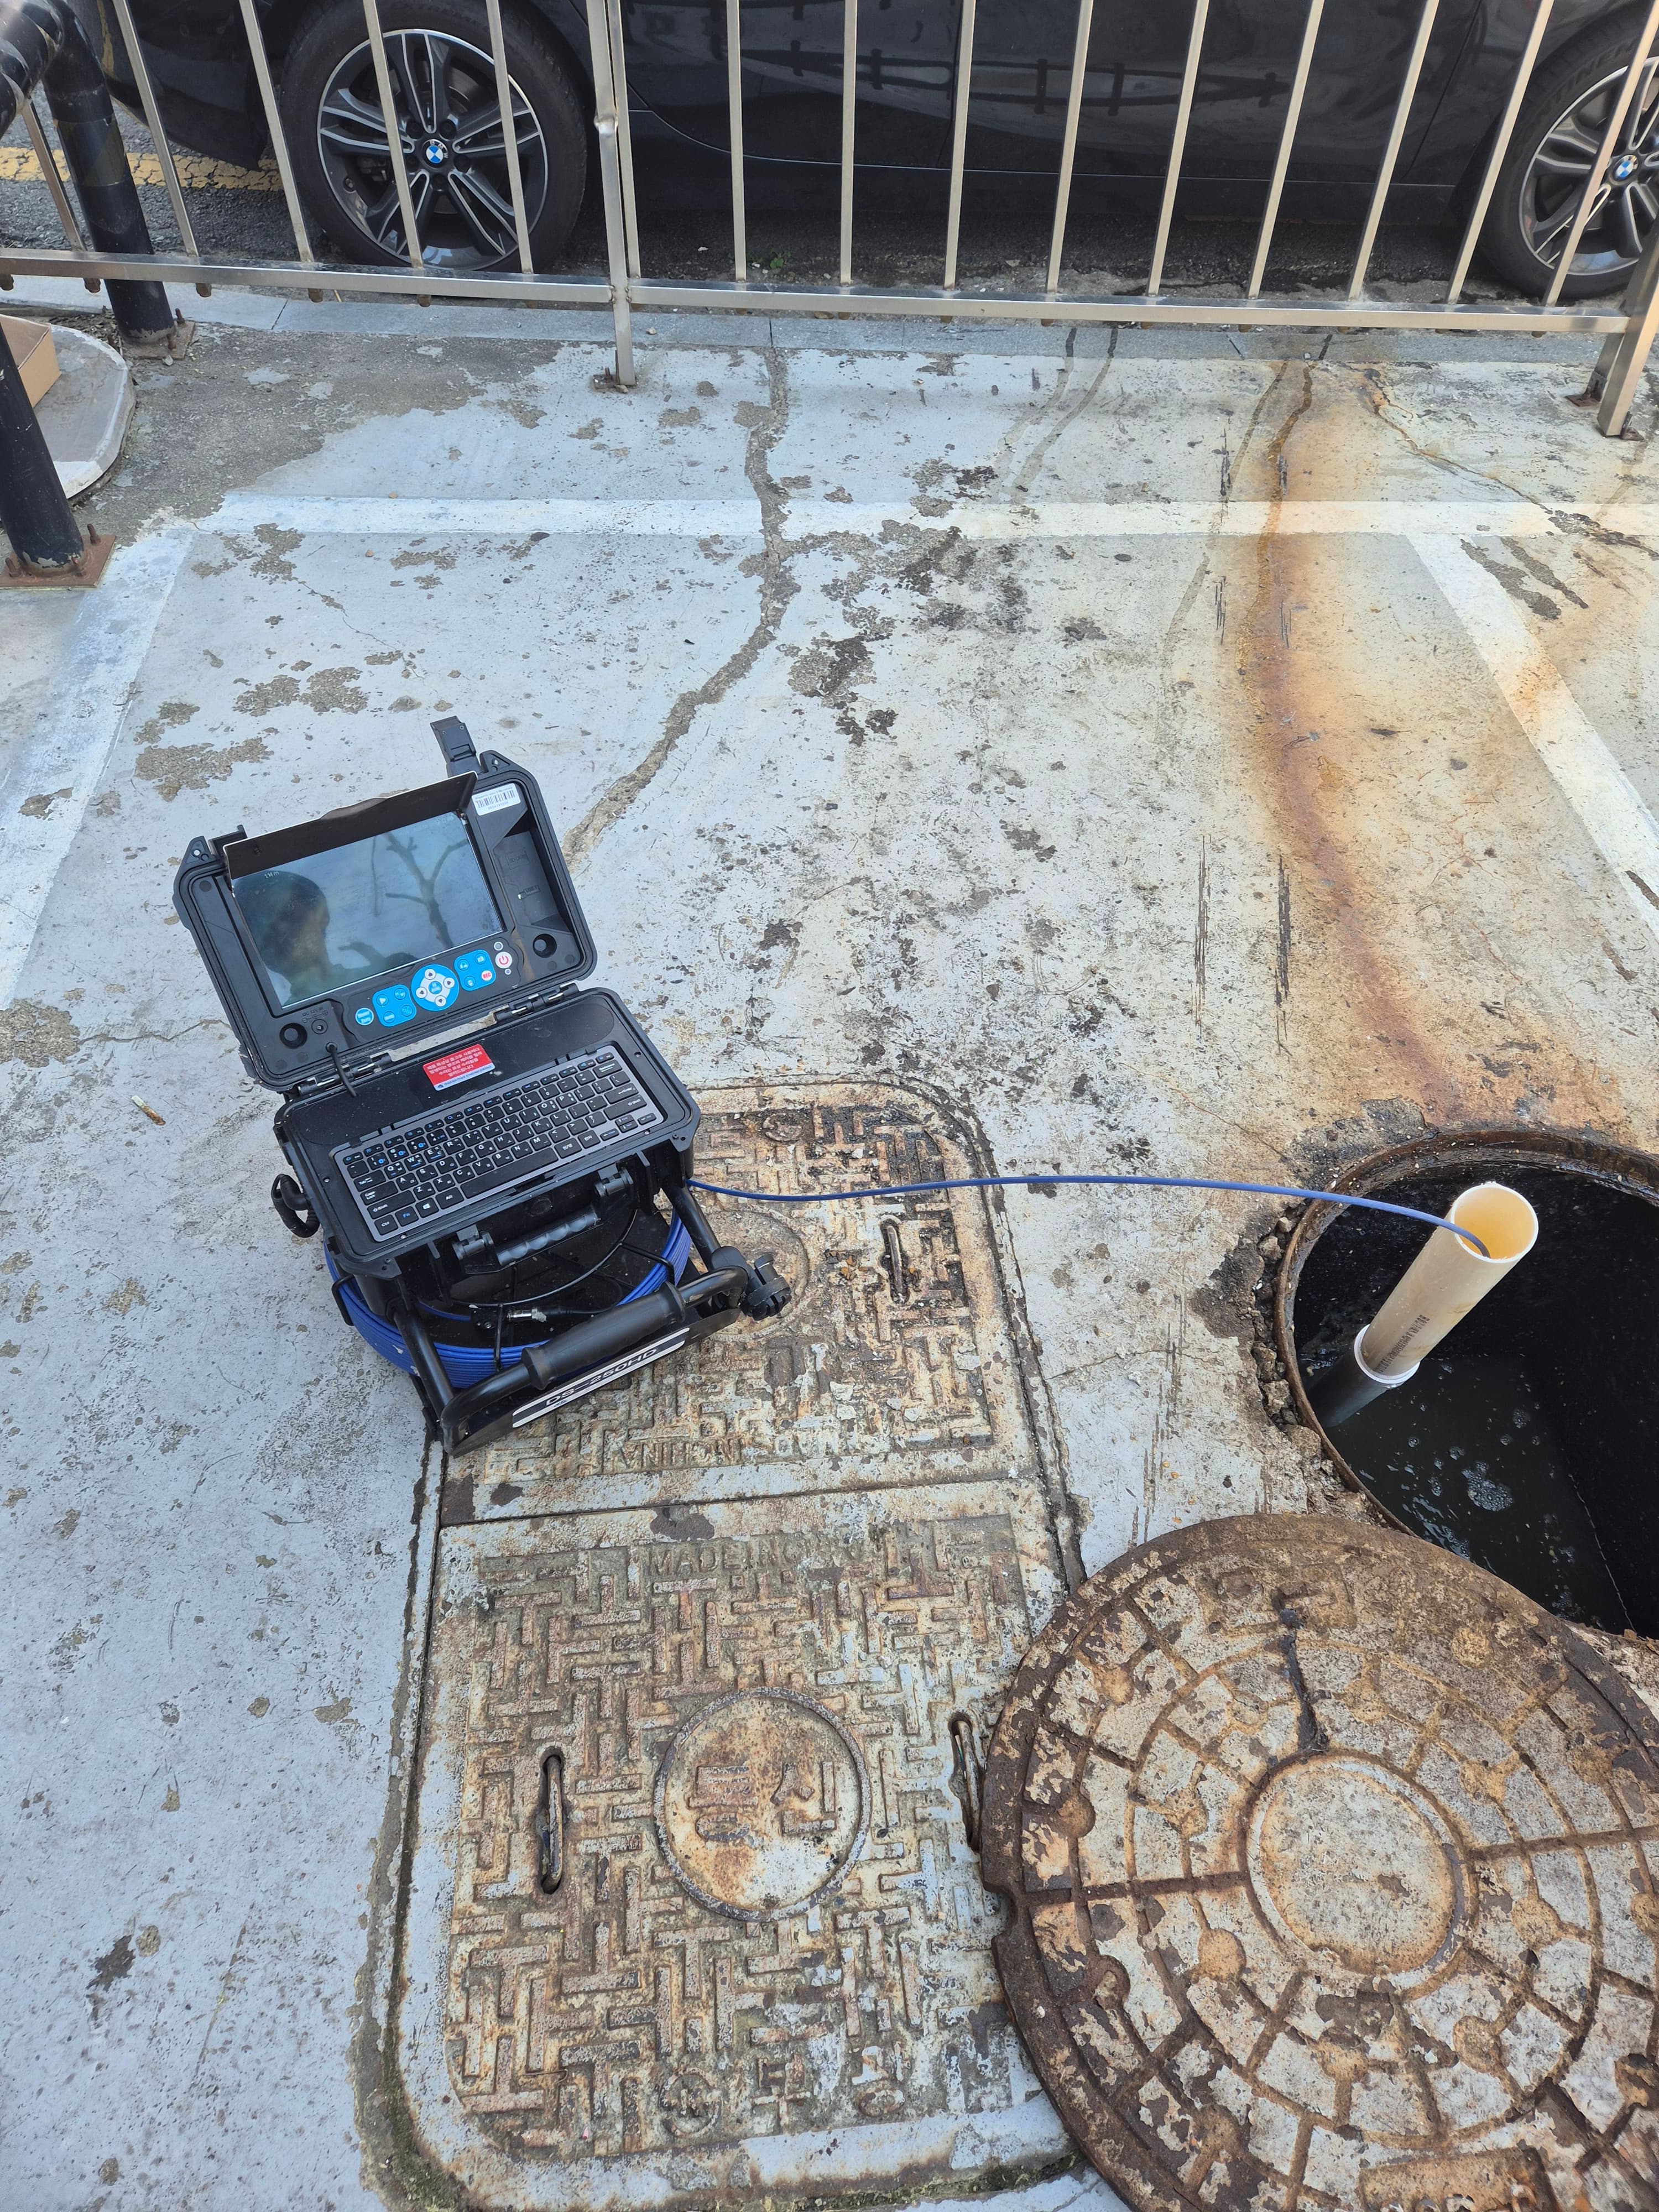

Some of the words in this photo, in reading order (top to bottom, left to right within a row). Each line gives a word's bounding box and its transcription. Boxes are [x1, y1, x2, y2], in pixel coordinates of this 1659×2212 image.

[429, 140, 448, 158] BMW
[648, 1543, 742, 1577] MADE
[687, 1761, 837, 1843] 통신
